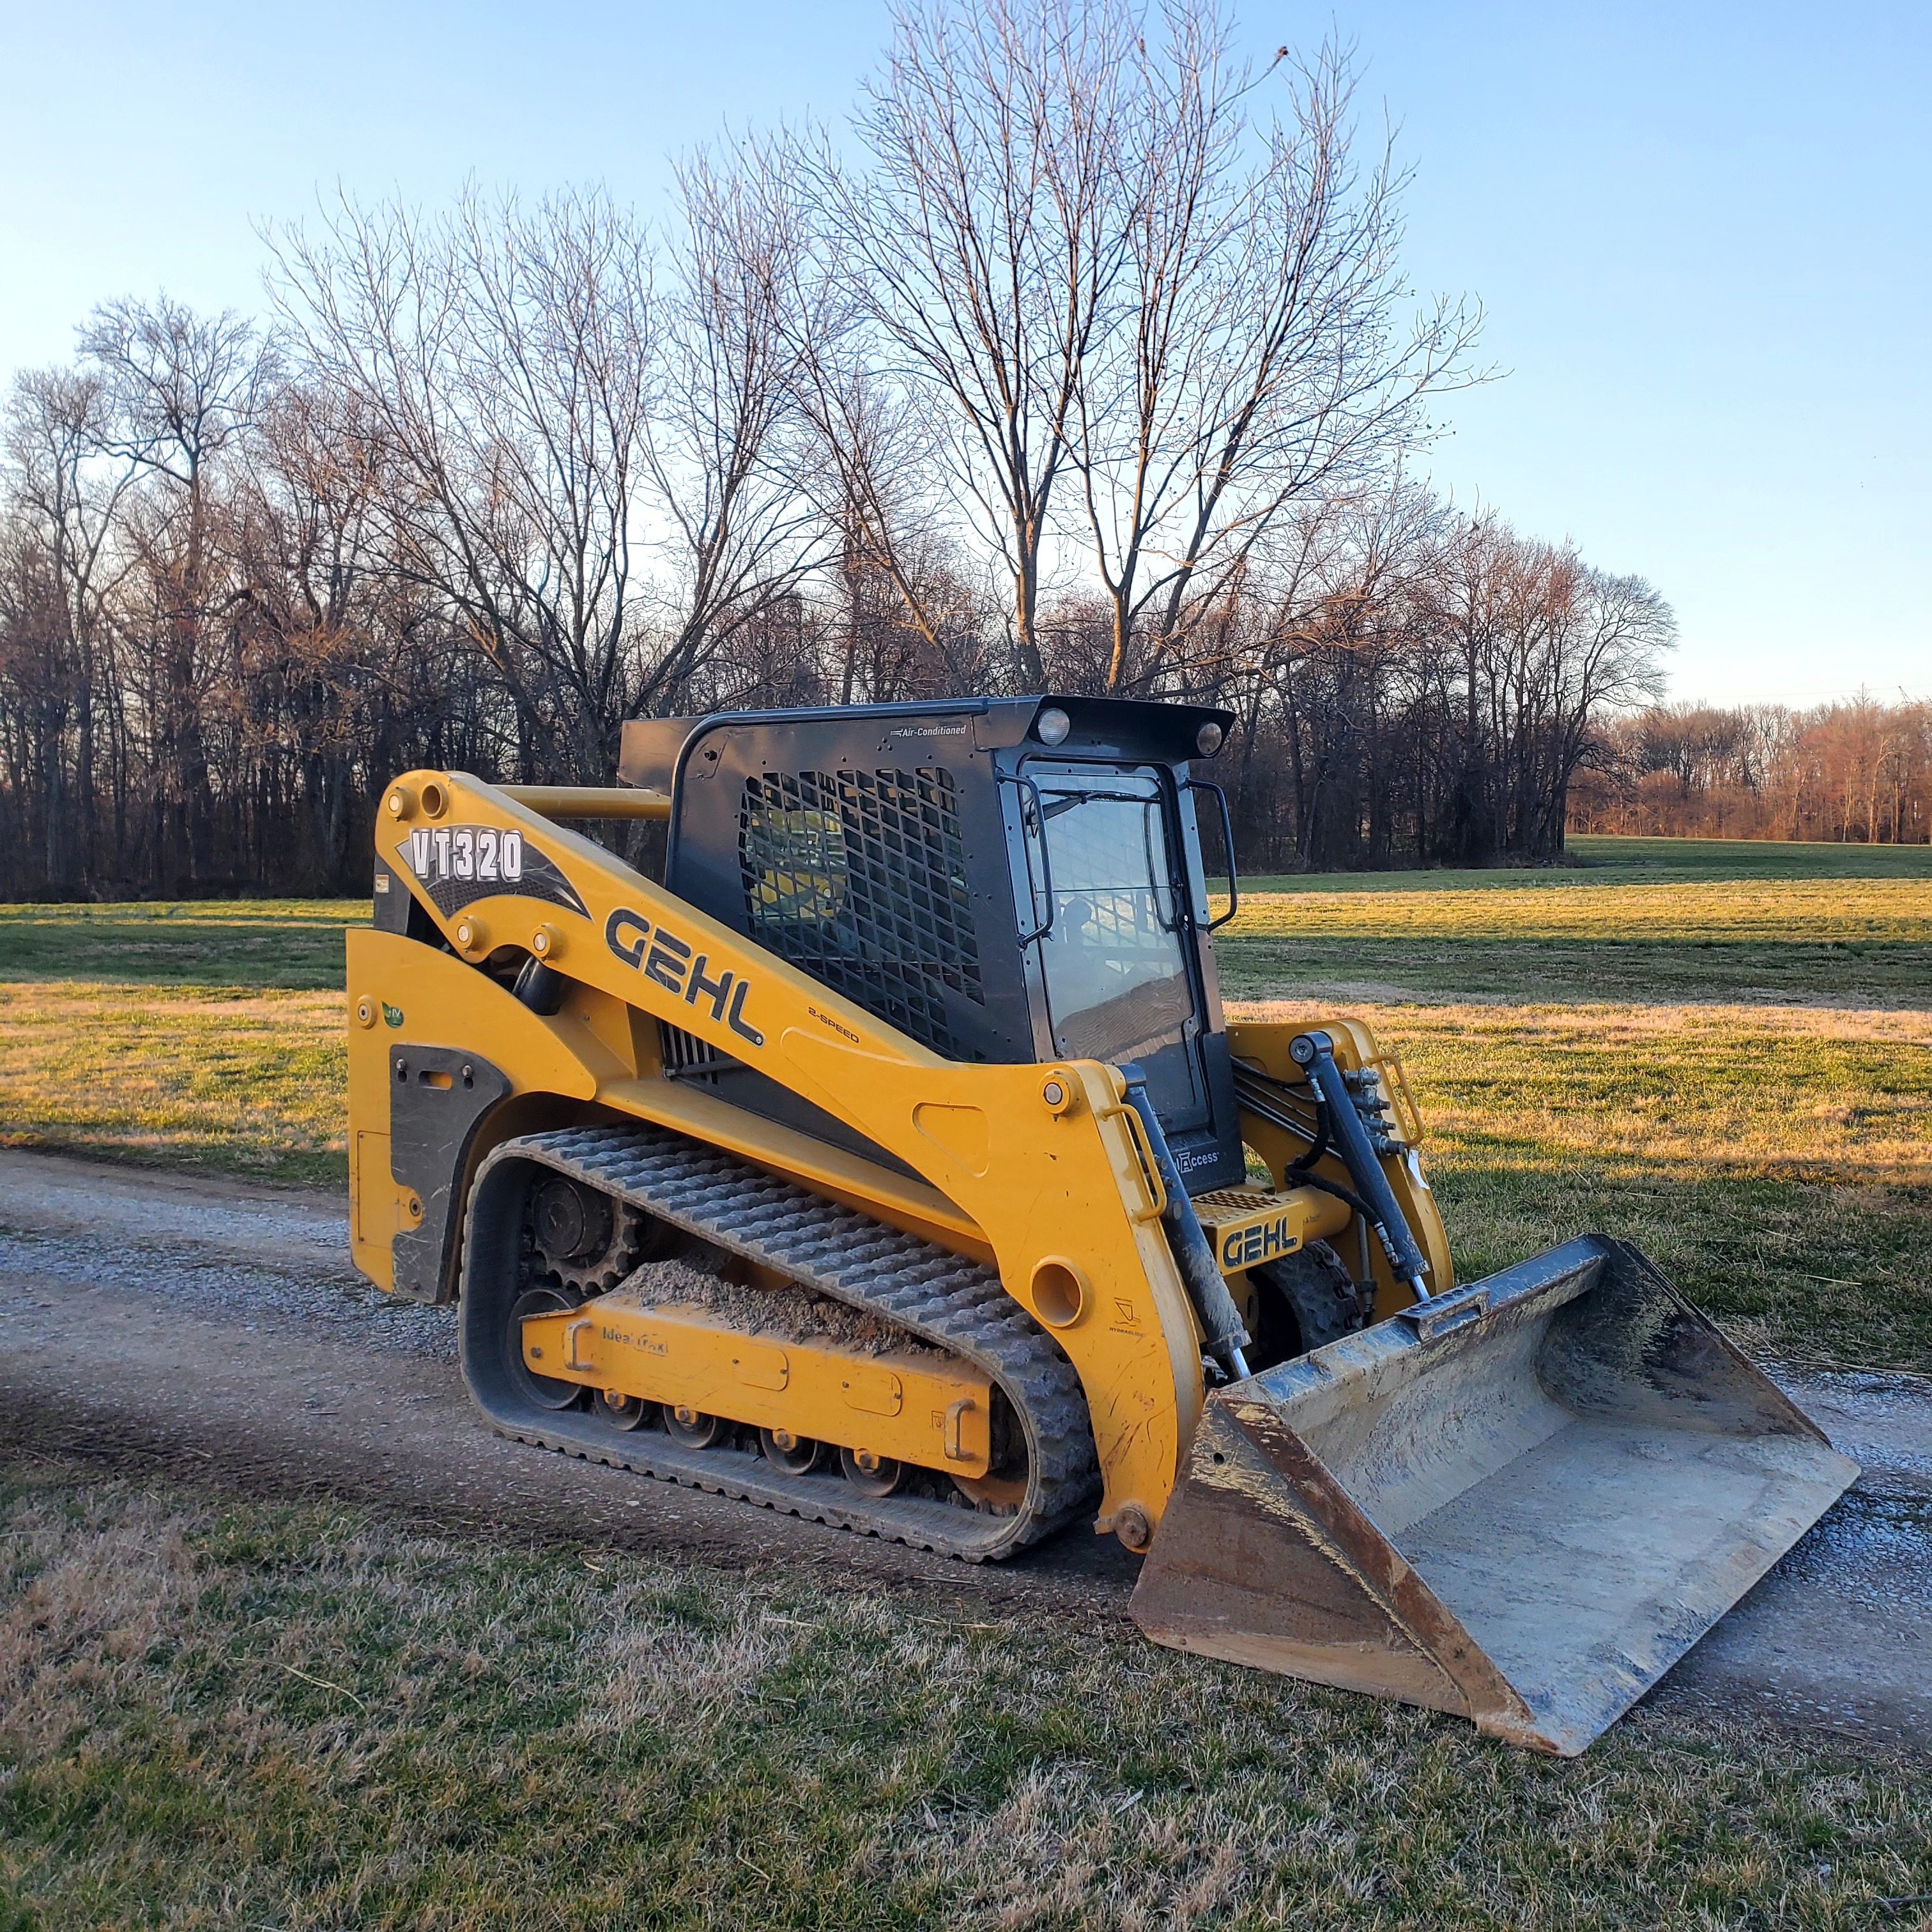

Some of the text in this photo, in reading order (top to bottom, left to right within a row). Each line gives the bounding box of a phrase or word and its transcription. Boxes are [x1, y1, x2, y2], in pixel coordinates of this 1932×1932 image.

[901, 724, 967, 737] Air-Conditioned
[410, 829, 523, 882] VT320
[604, 907, 765, 1048] GEHL
[808, 1006, 859, 1043] 2-SPEED
[1223, 1215, 1298, 1268] GEHL
